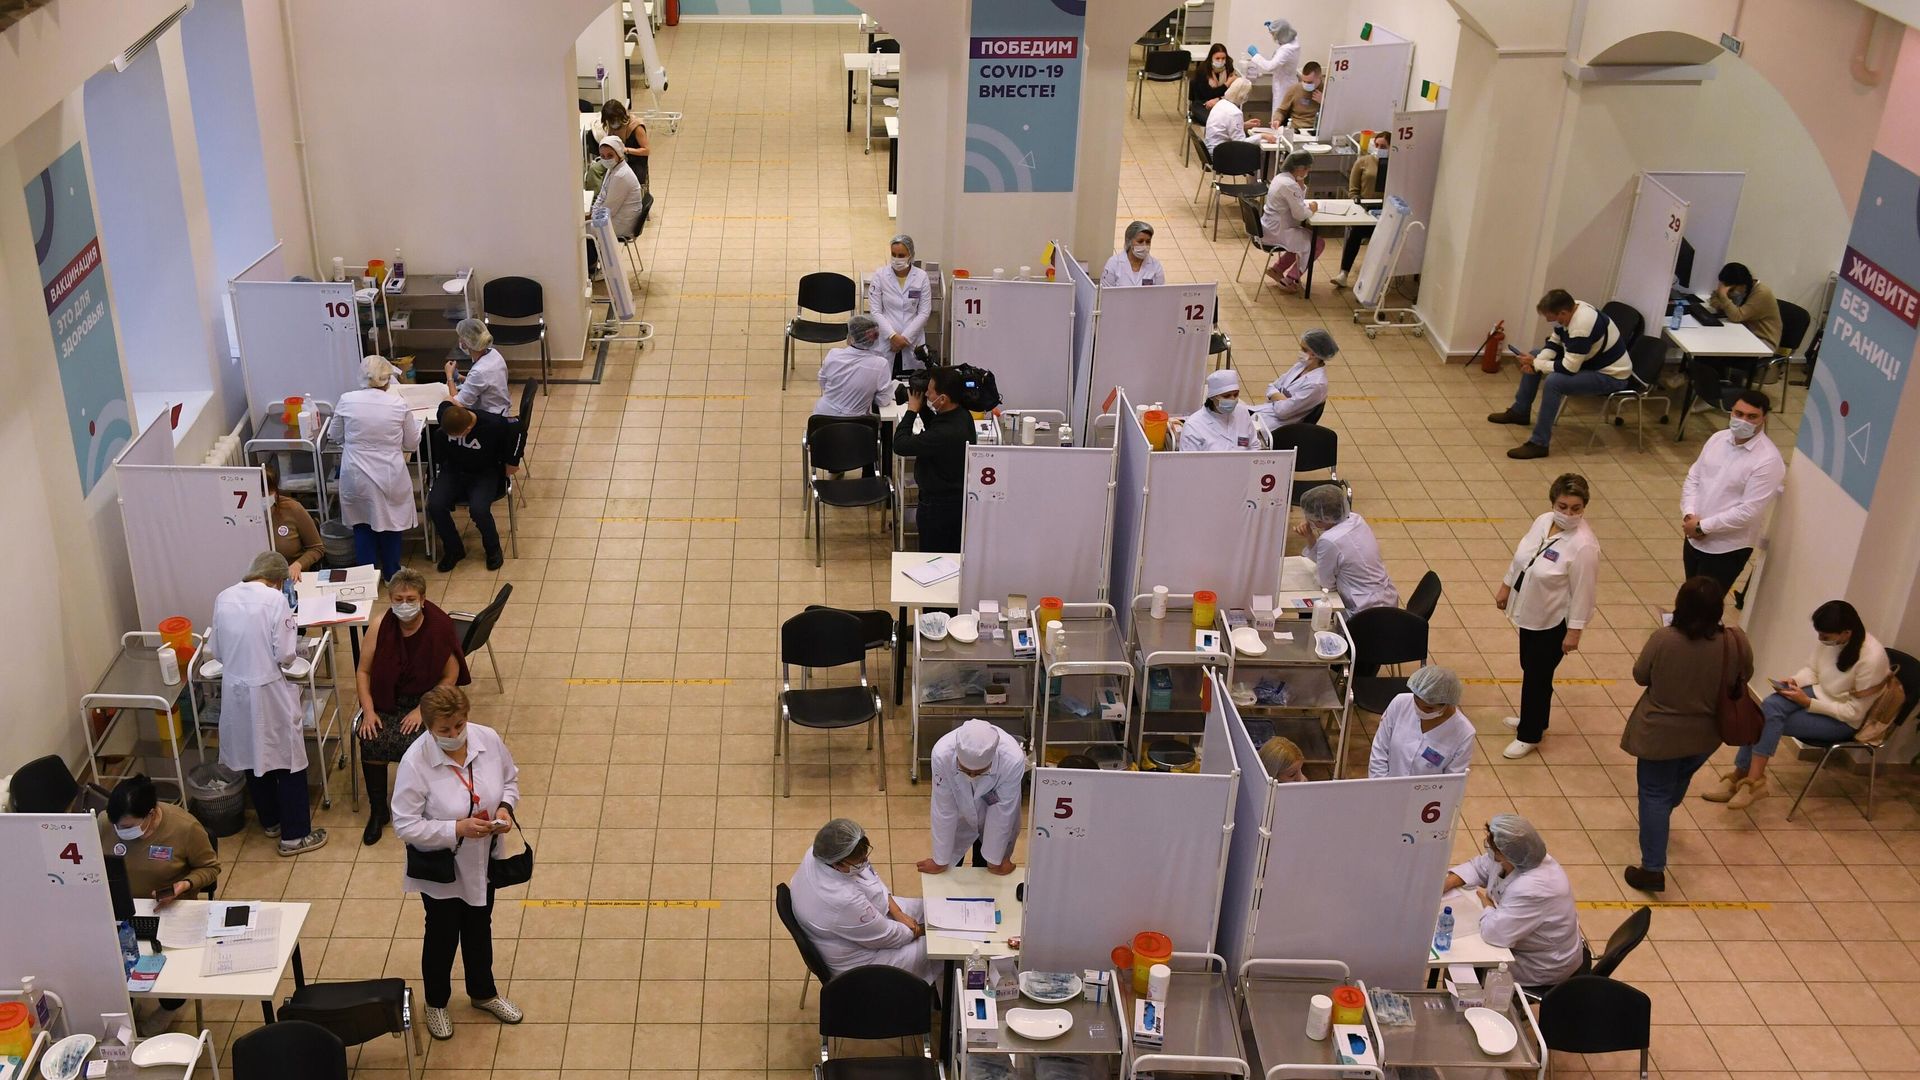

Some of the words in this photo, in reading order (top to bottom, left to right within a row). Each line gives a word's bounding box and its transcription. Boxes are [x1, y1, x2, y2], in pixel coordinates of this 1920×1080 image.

[981, 41, 1072, 56] ПОБЕДИМ
[980, 64, 1064, 78] COVID-19
[1334, 60, 1349, 71] 18
[979, 84, 1056, 98] ВМЕСТЕ!
[1398, 126, 1413, 140] 15
[1668, 214, 1680, 232] 29
[50, 246, 98, 303] ВАКЦИНАЦИЯ
[1848, 256, 1918, 319] ЖИВИТЕ
[57, 307, 75, 335] ЭТО
[74, 289, 91, 320] ДЛЯ
[325, 302, 350, 318] 10
[965, 299, 981, 314] 11
[1184, 304, 1204, 320] 12
[1840, 287, 1870, 323] БЕЗ
[61, 301, 105, 358] ЗДОРОВЬЯ!
[1832, 315, 1902, 381] ГРАНИЦ!
[980, 467, 996, 485] 8
[1261, 474, 1276, 492] 9
[233, 491, 248, 509] 7
[1054, 797, 1073, 819] 5
[1421, 801, 1441, 824] 6
[60, 843, 83, 864] 4
